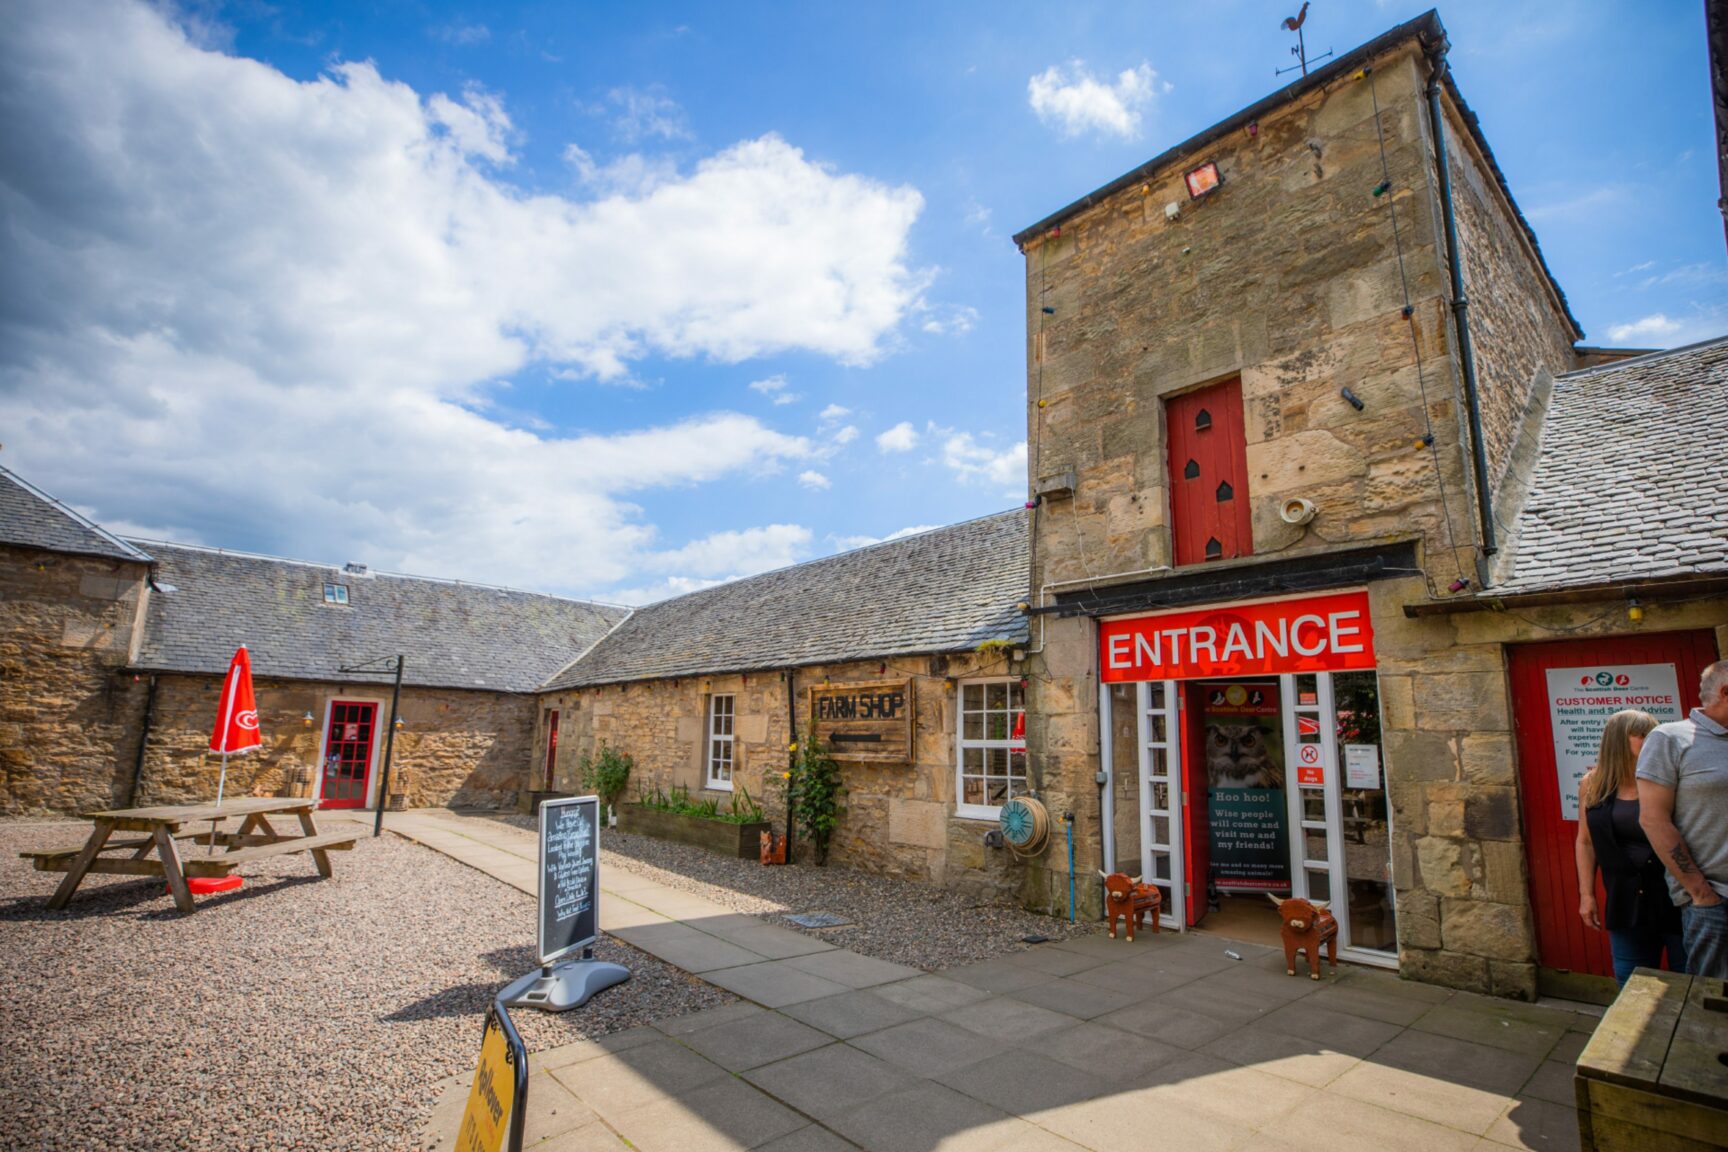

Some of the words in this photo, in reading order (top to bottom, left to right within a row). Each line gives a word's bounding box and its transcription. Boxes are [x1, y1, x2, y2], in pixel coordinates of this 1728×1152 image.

[1108, 610, 1364, 669] ENTRANCE
[1556, 696, 1622, 706] CUSTOMER
[1626, 695, 1673, 704] NOTICE
[818, 695, 856, 719] FARM
[860, 692, 905, 719] SHOP
[1557, 707, 1586, 715] Health
[1641, 706, 1674, 714] Advice
[1580, 718, 1601, 726] entry
[1215, 792, 1240, 802] Hoo
[1243, 793, 1270, 802] hoo!
[1215, 809, 1239, 818] Wise
[1241, 810, 1274, 820] people
[1210, 820, 1230, 828] will
[1232, 821, 1259, 829] come
[1261, 821, 1280, 829] and
[1215, 830, 1237, 838] visit
[1258, 831, 1276, 839] and
[1217, 841, 1233, 850] my
[1235, 841, 1275, 850] friends!
